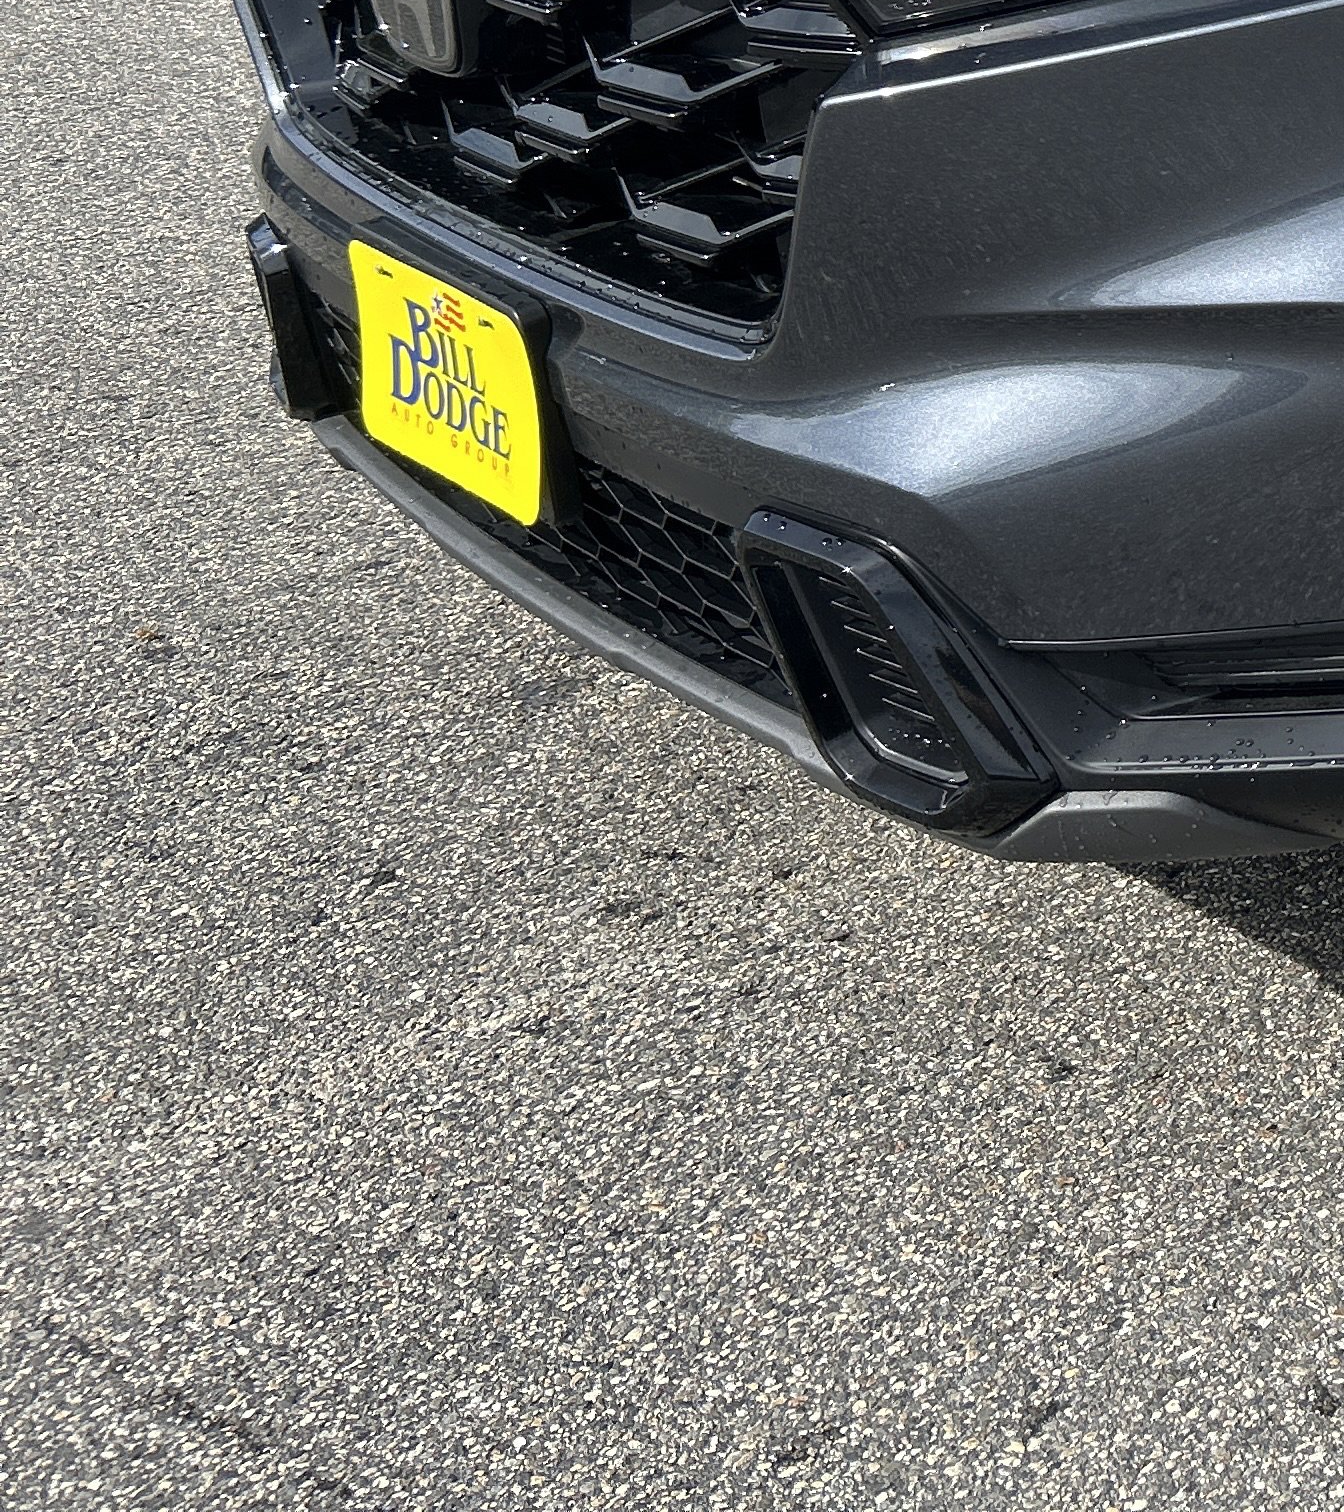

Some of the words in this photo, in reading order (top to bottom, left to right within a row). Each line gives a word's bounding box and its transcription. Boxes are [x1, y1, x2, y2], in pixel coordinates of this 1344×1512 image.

[404, 297, 486, 396] BILL
[389, 334, 512, 461] DODGE
[391, 402, 434, 435] AUTO
[451, 433, 511, 477] GROUP
